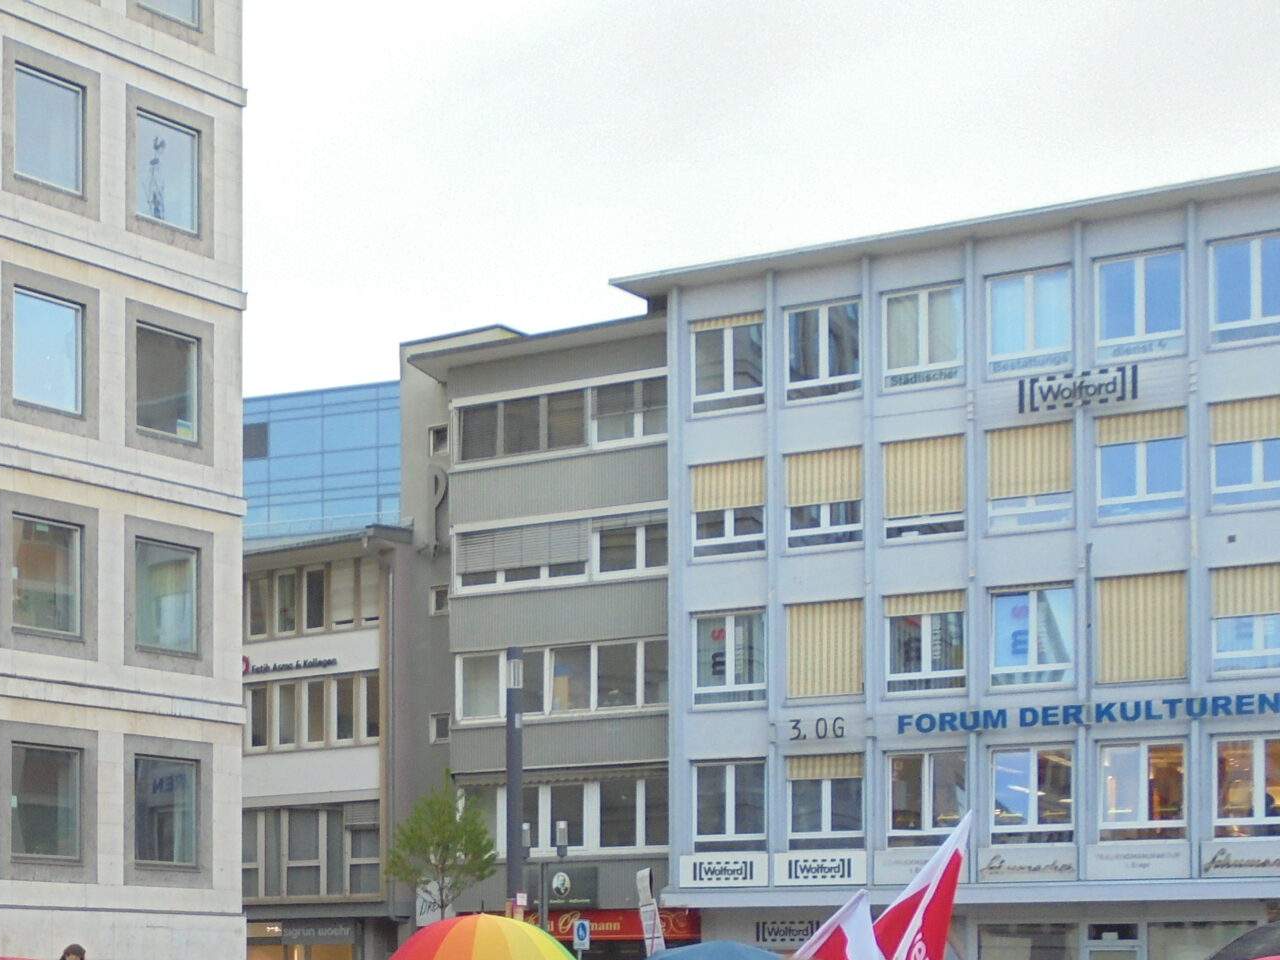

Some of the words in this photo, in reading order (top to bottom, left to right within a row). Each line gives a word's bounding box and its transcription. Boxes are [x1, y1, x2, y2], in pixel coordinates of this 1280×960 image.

[1038, 375, 1118, 403] Wolford
[897, 707, 1008, 735] FORUM
[1019, 704, 1083, 729] DER
[1094, 692, 1280, 724] KULTUREN
[703, 862, 744, 876] Wolford
[799, 861, 841, 875] Wolford
[767, 921, 810, 937] Wolford
